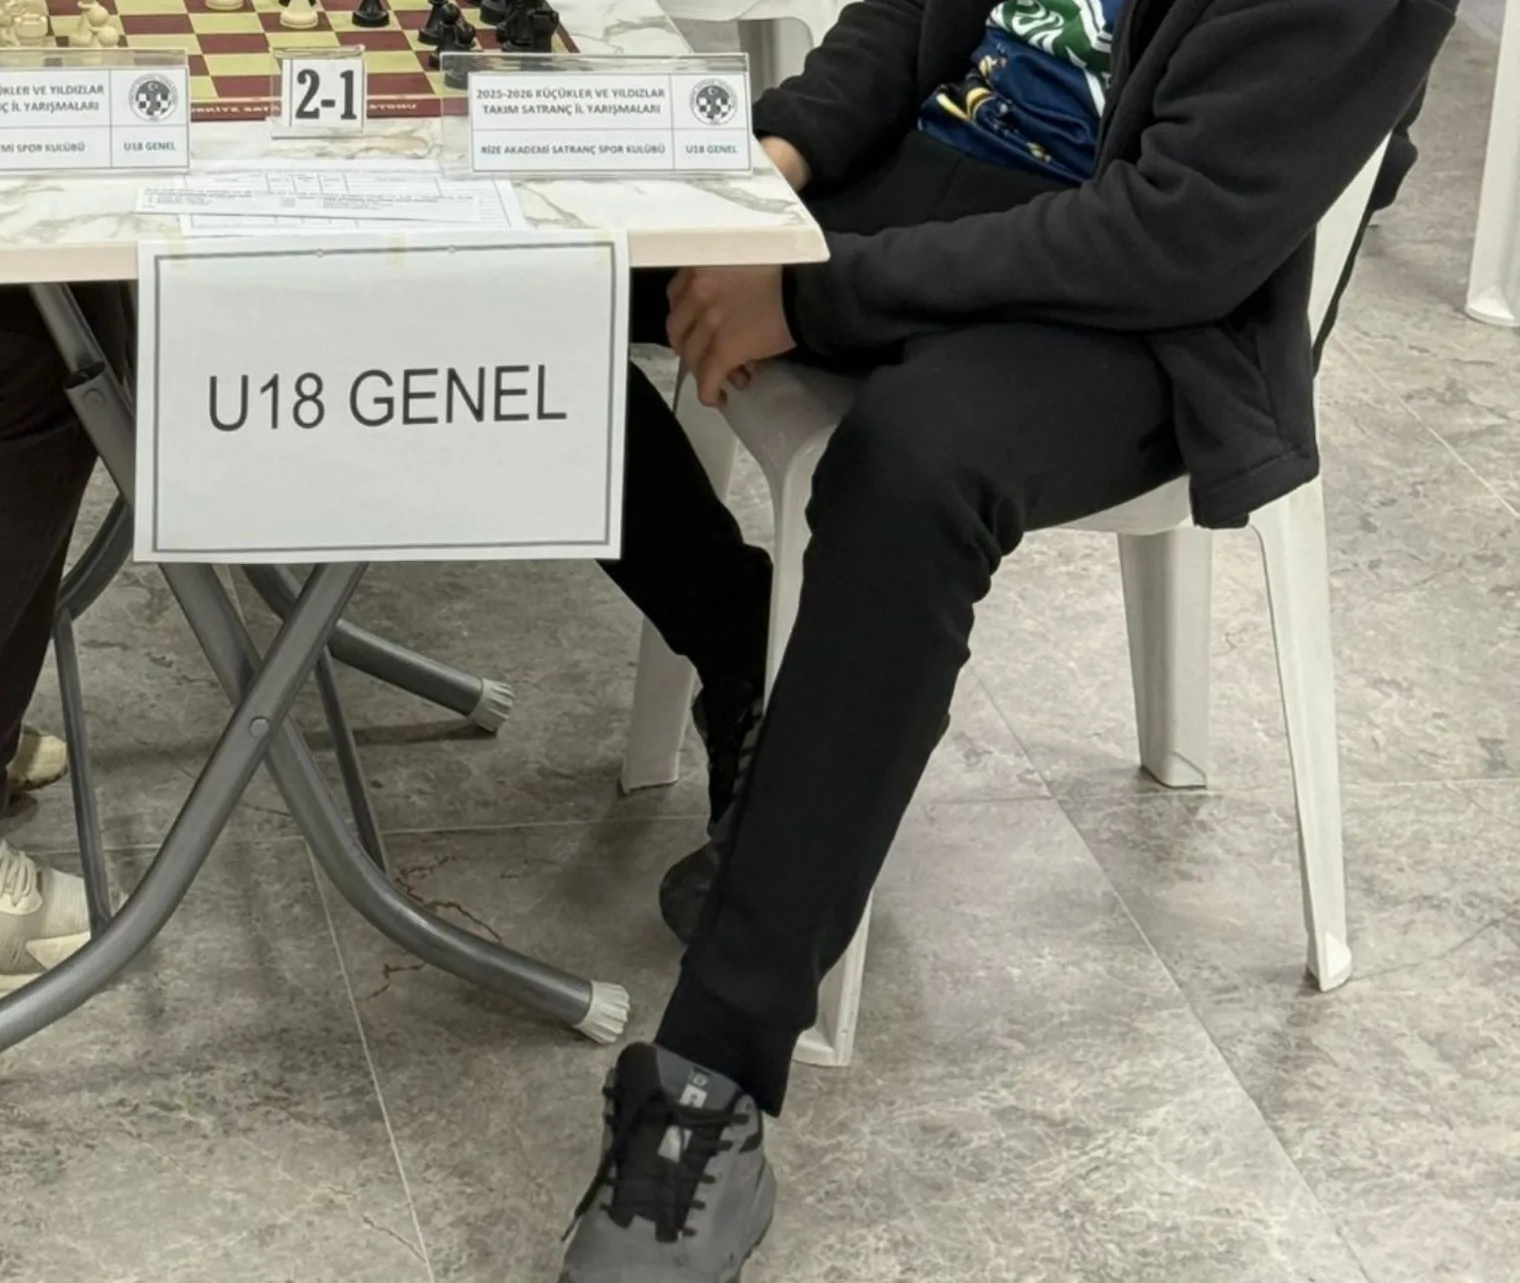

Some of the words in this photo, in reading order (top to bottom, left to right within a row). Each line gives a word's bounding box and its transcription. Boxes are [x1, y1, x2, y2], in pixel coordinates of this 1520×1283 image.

[33, 85, 47, 96] VE
[50, 84, 104, 96] YILDIZLAR
[295, 69, 357, 120] 2-1
[477, 89, 533, 99] 2025-2026
[535, 87, 593, 102] KÜÇÜKLER
[596, 89, 609, 99] VE
[612, 89, 665, 99] YILDIZLAR
[23, 101, 99, 114] YARIŞMALARI
[482, 105, 518, 115] TAKIM
[521, 104, 572, 117] SATRANÇ
[586, 104, 661, 116] YARIŞMALARI
[16, 142, 42, 153] SPOR
[124, 142, 143, 151] U18
[145, 141, 176, 151] GENEL
[552, 144, 596, 156] SATRANÇ
[599, 145, 624, 154] SPOR
[686, 145, 705, 154] U18
[707, 145, 738, 154] GENEL
[209, 372, 325, 432] U18
[349, 364, 567, 427] GENEL
